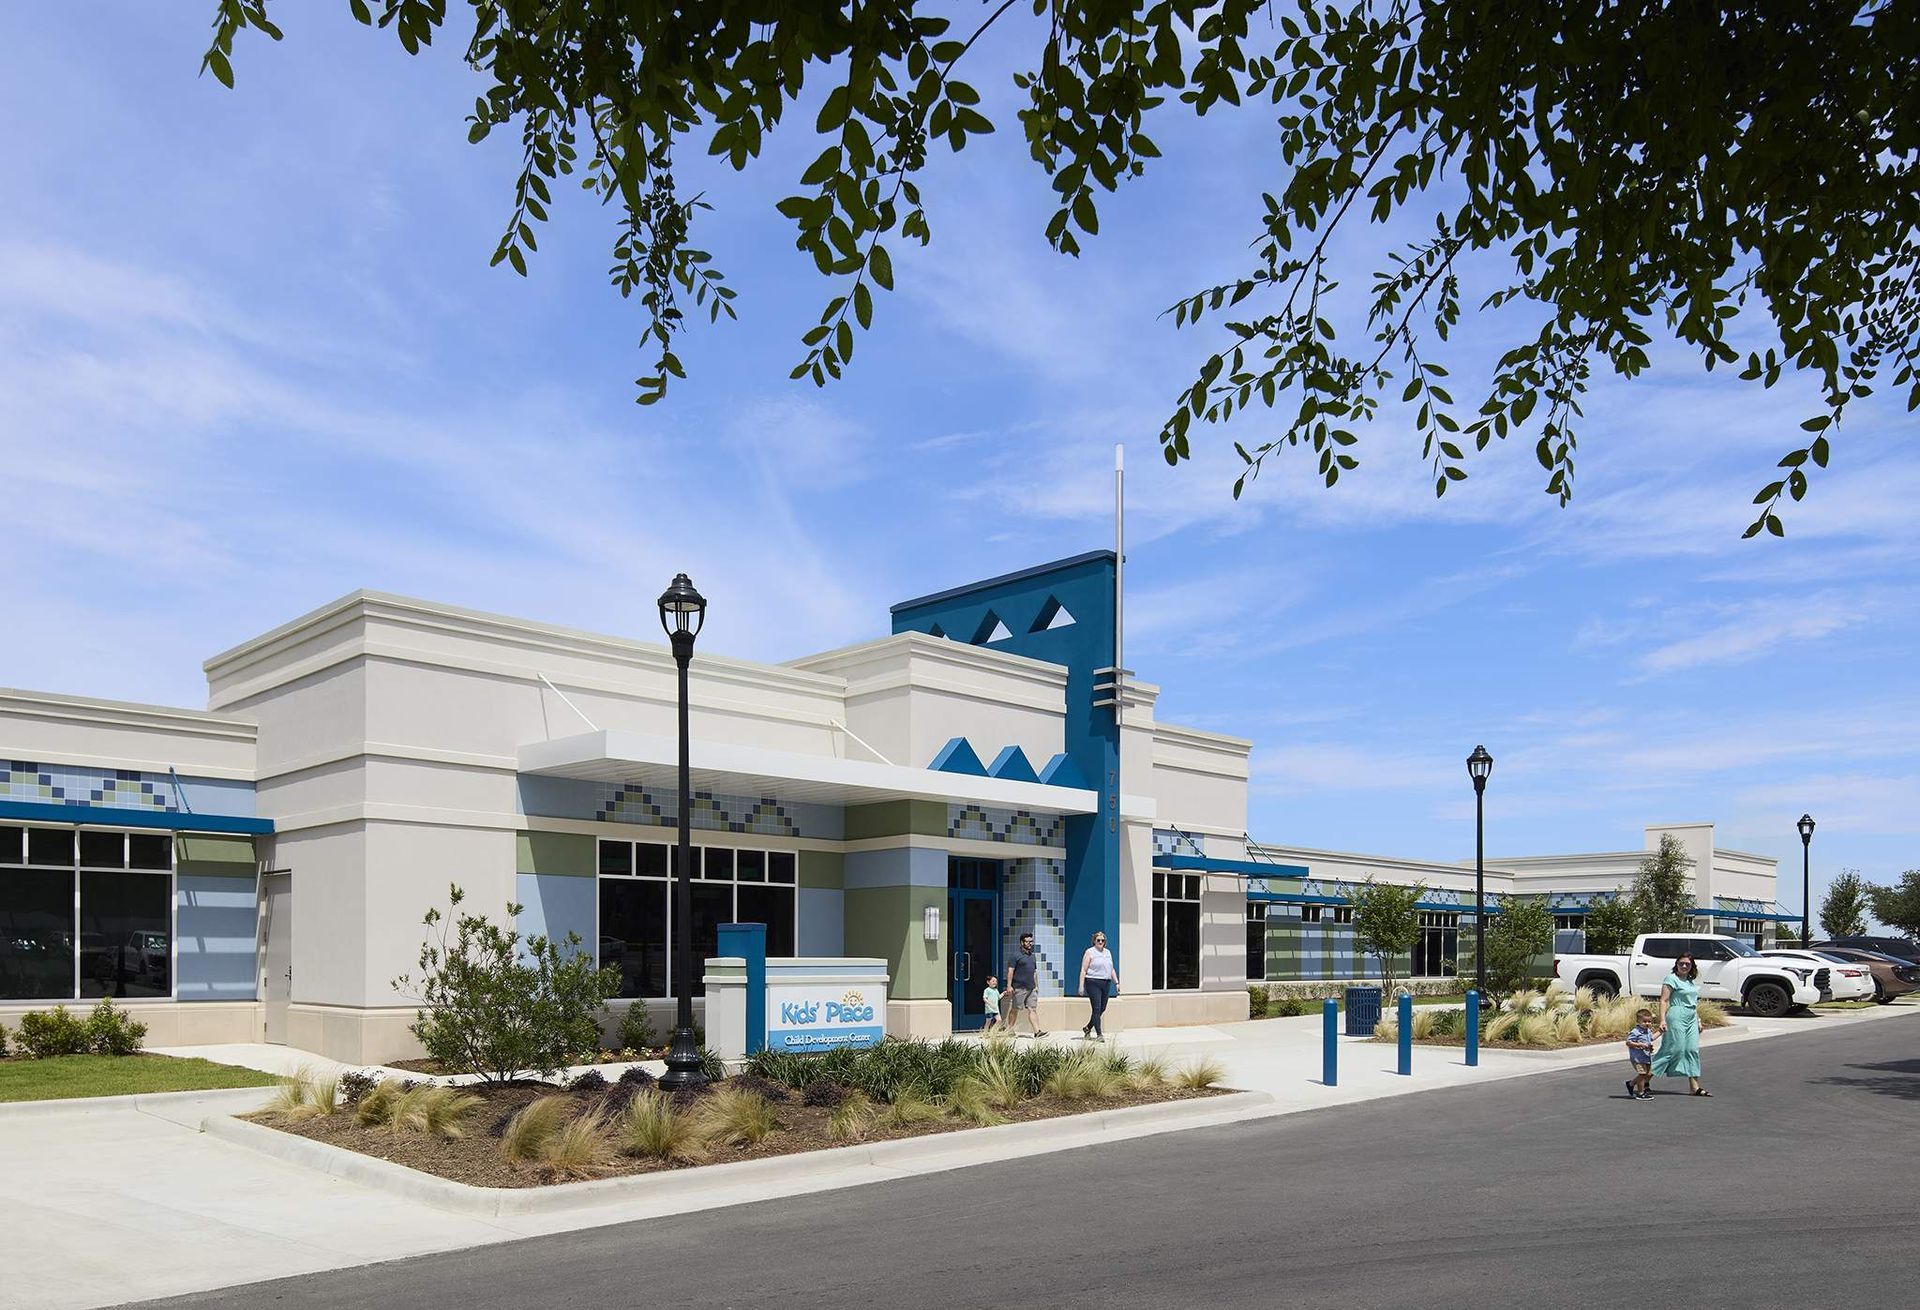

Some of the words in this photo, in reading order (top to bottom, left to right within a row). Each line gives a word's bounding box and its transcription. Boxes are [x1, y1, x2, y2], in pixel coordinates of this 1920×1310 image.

[781, 1000, 820, 1025] Kids'
[826, 1001, 874, 1023] Place
[785, 1034, 804, 1045] Child
[805, 1032, 848, 1046] Development
